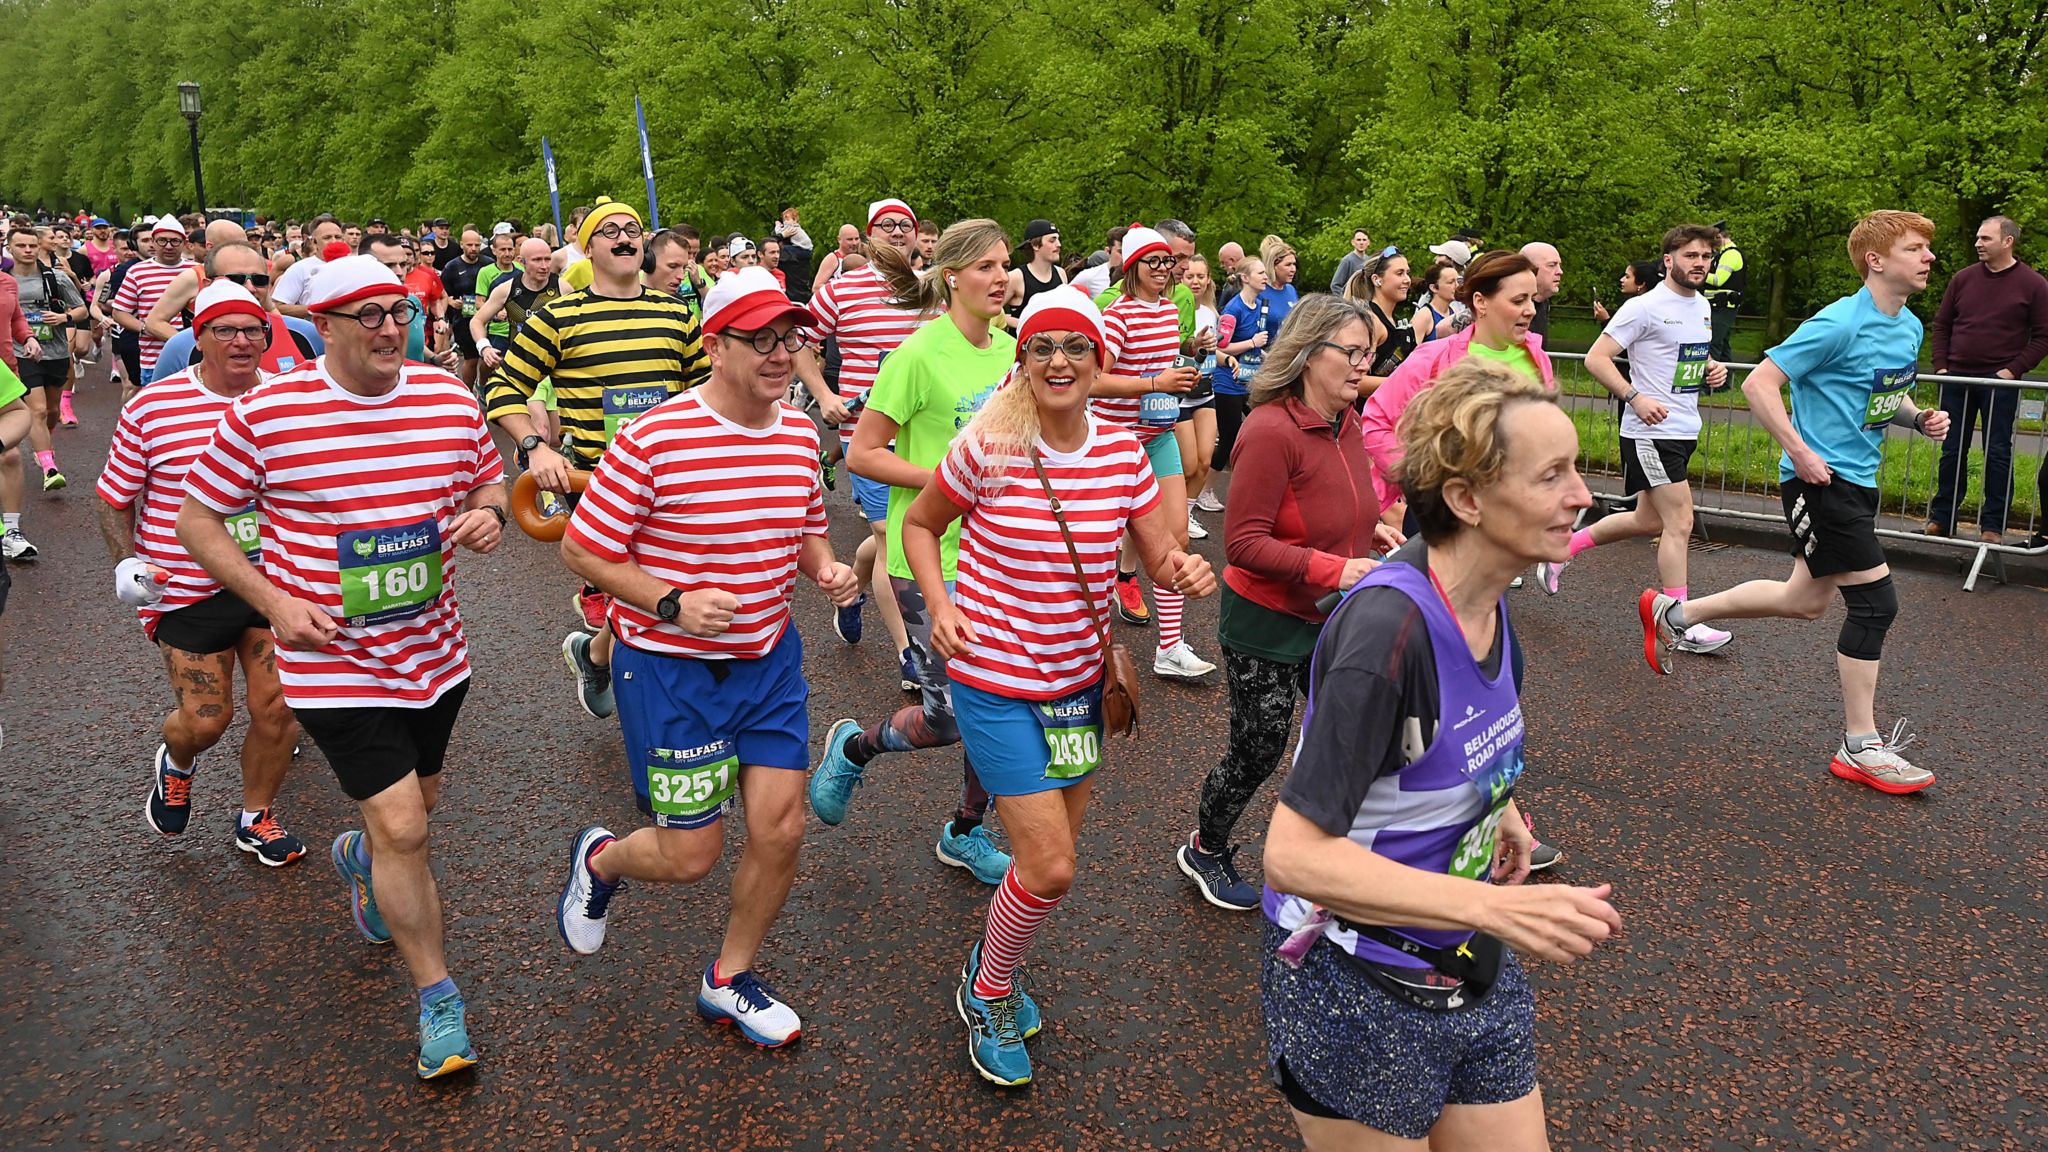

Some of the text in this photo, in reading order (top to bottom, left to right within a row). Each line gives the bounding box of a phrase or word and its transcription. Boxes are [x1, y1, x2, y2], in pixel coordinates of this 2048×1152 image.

[1682, 363, 1706, 380] 214
[628, 397, 662, 406] BELFAST
[1870, 387, 1910, 416] 396
[377, 535, 430, 554] BELFAST
[361, 562, 428, 601] 160
[382, 600, 414, 610] MARATHON
[1054, 705, 1089, 718] BELFAST
[674, 740, 724, 759] BELFAST
[1049, 731, 1098, 765] 2430
[1467, 743, 1495, 773] ROAD
[652, 764, 729, 804] 3251
[680, 804, 709, 815] MARATHON
